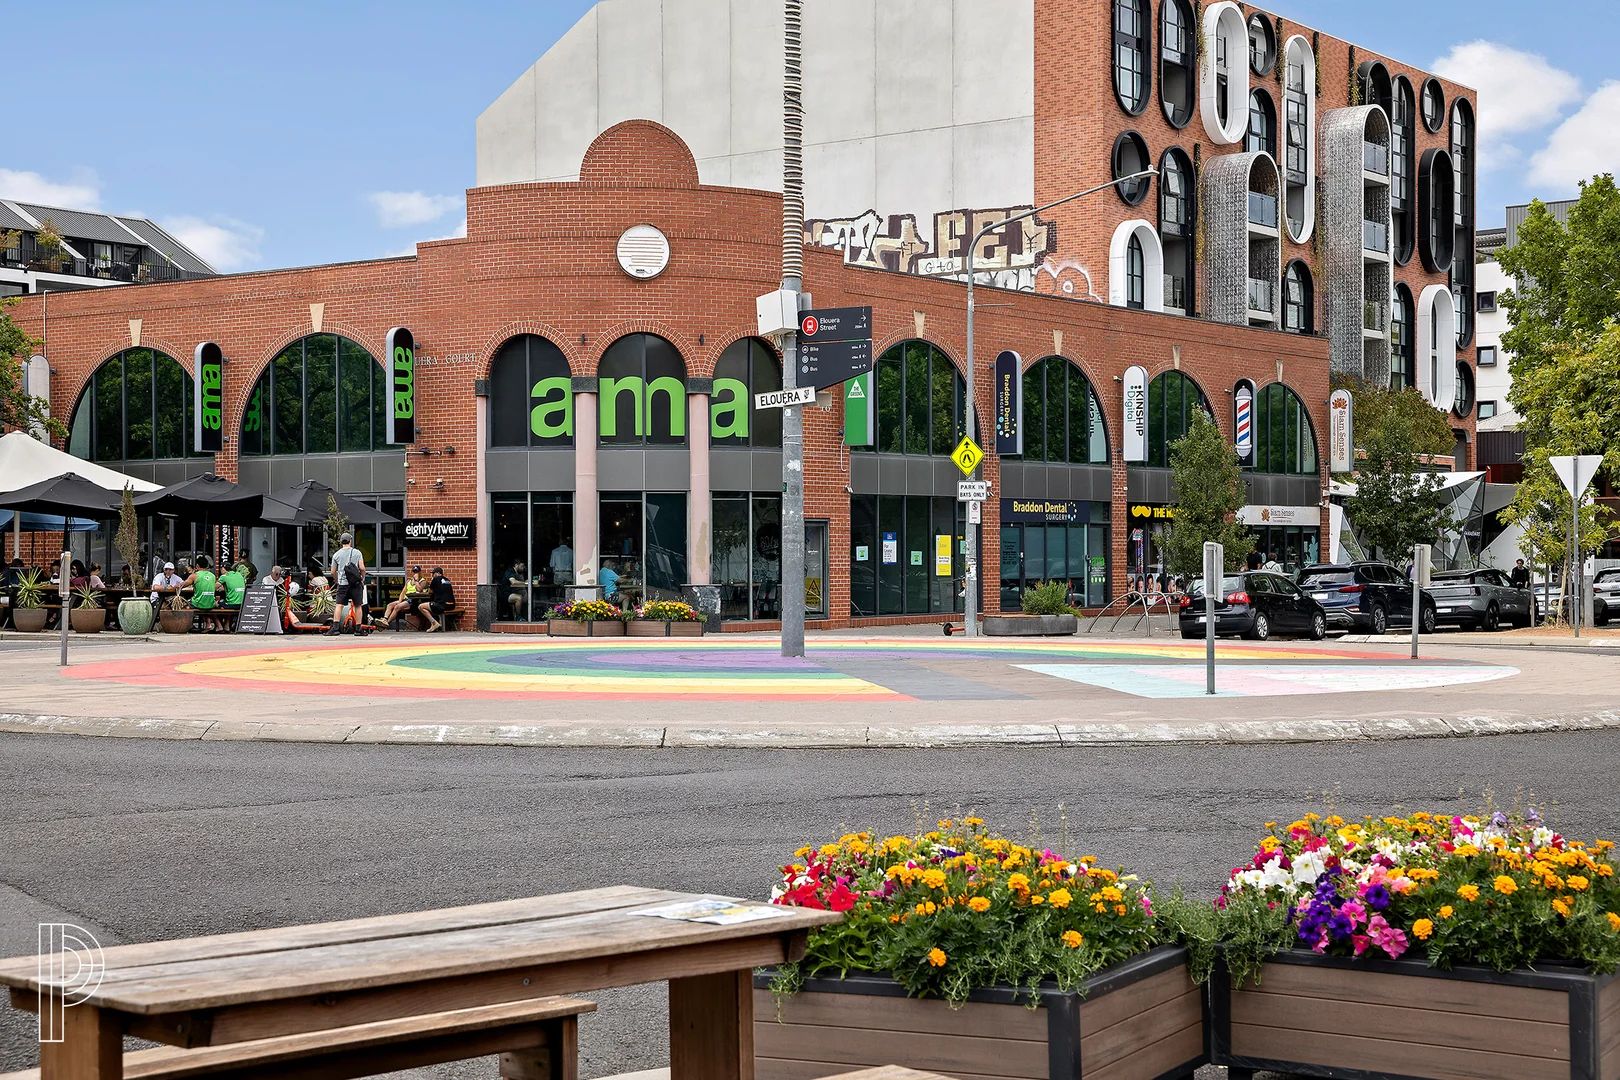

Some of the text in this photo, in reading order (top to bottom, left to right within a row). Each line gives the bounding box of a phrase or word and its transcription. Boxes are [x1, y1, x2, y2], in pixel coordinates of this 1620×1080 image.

[414, 352, 476, 366] UERA COURT
[394, 346, 413, 419] ama
[202, 363, 222, 430] ama
[760, 391, 801, 406] ELOUERA
[530, 376, 749, 438] ama
[1125, 390, 1136, 422] Digital
[1135, 390, 1144, 437] KINSHIP
[1013, 500, 1068, 513] Braddon Dental
[1153, 507, 1166, 518] THE
[1045, 513, 1068, 521] SURGERY
[405, 521, 469, 537] eighty/twenty
